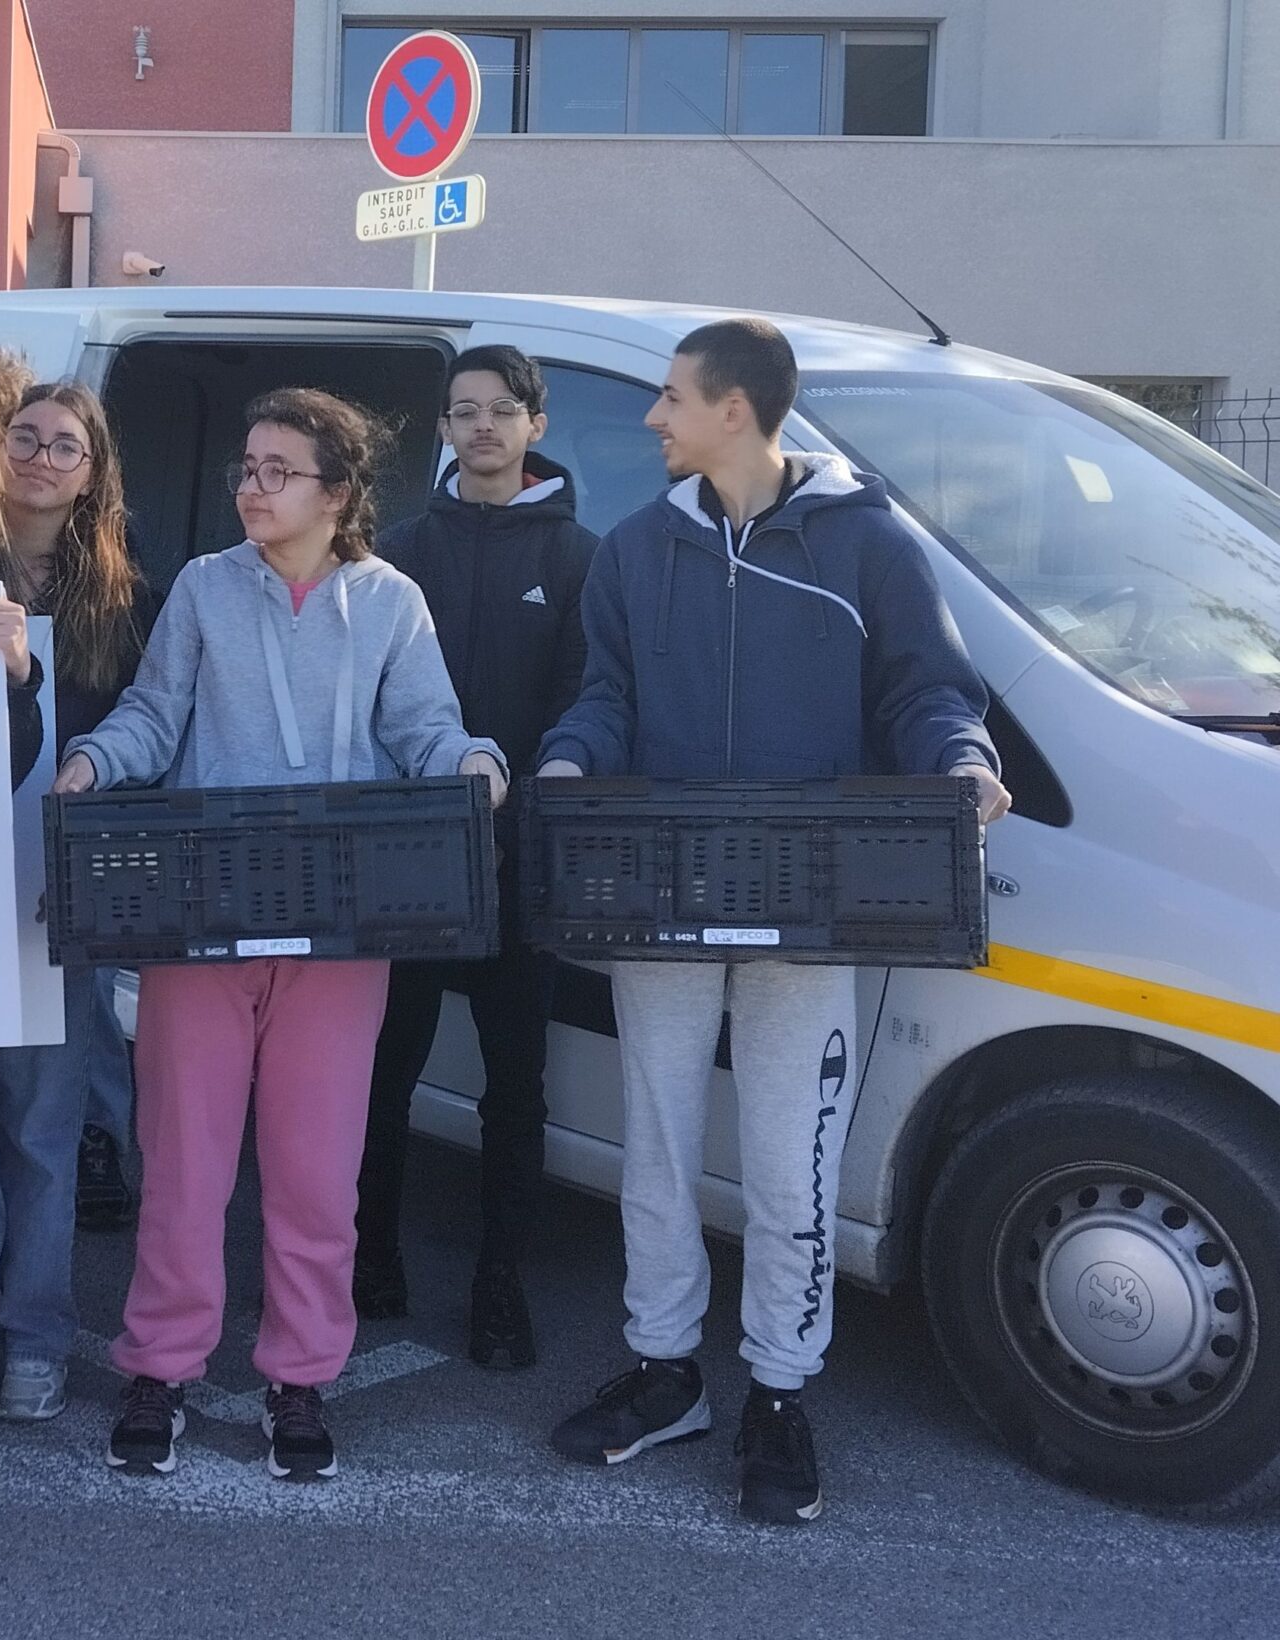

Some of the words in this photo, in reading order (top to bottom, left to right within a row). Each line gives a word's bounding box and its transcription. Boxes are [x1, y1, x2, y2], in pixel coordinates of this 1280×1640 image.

[367, 186, 426, 208] INTERDIT
[379, 203, 413, 220] SAUF
[792, 1028, 847, 1342] Champion
